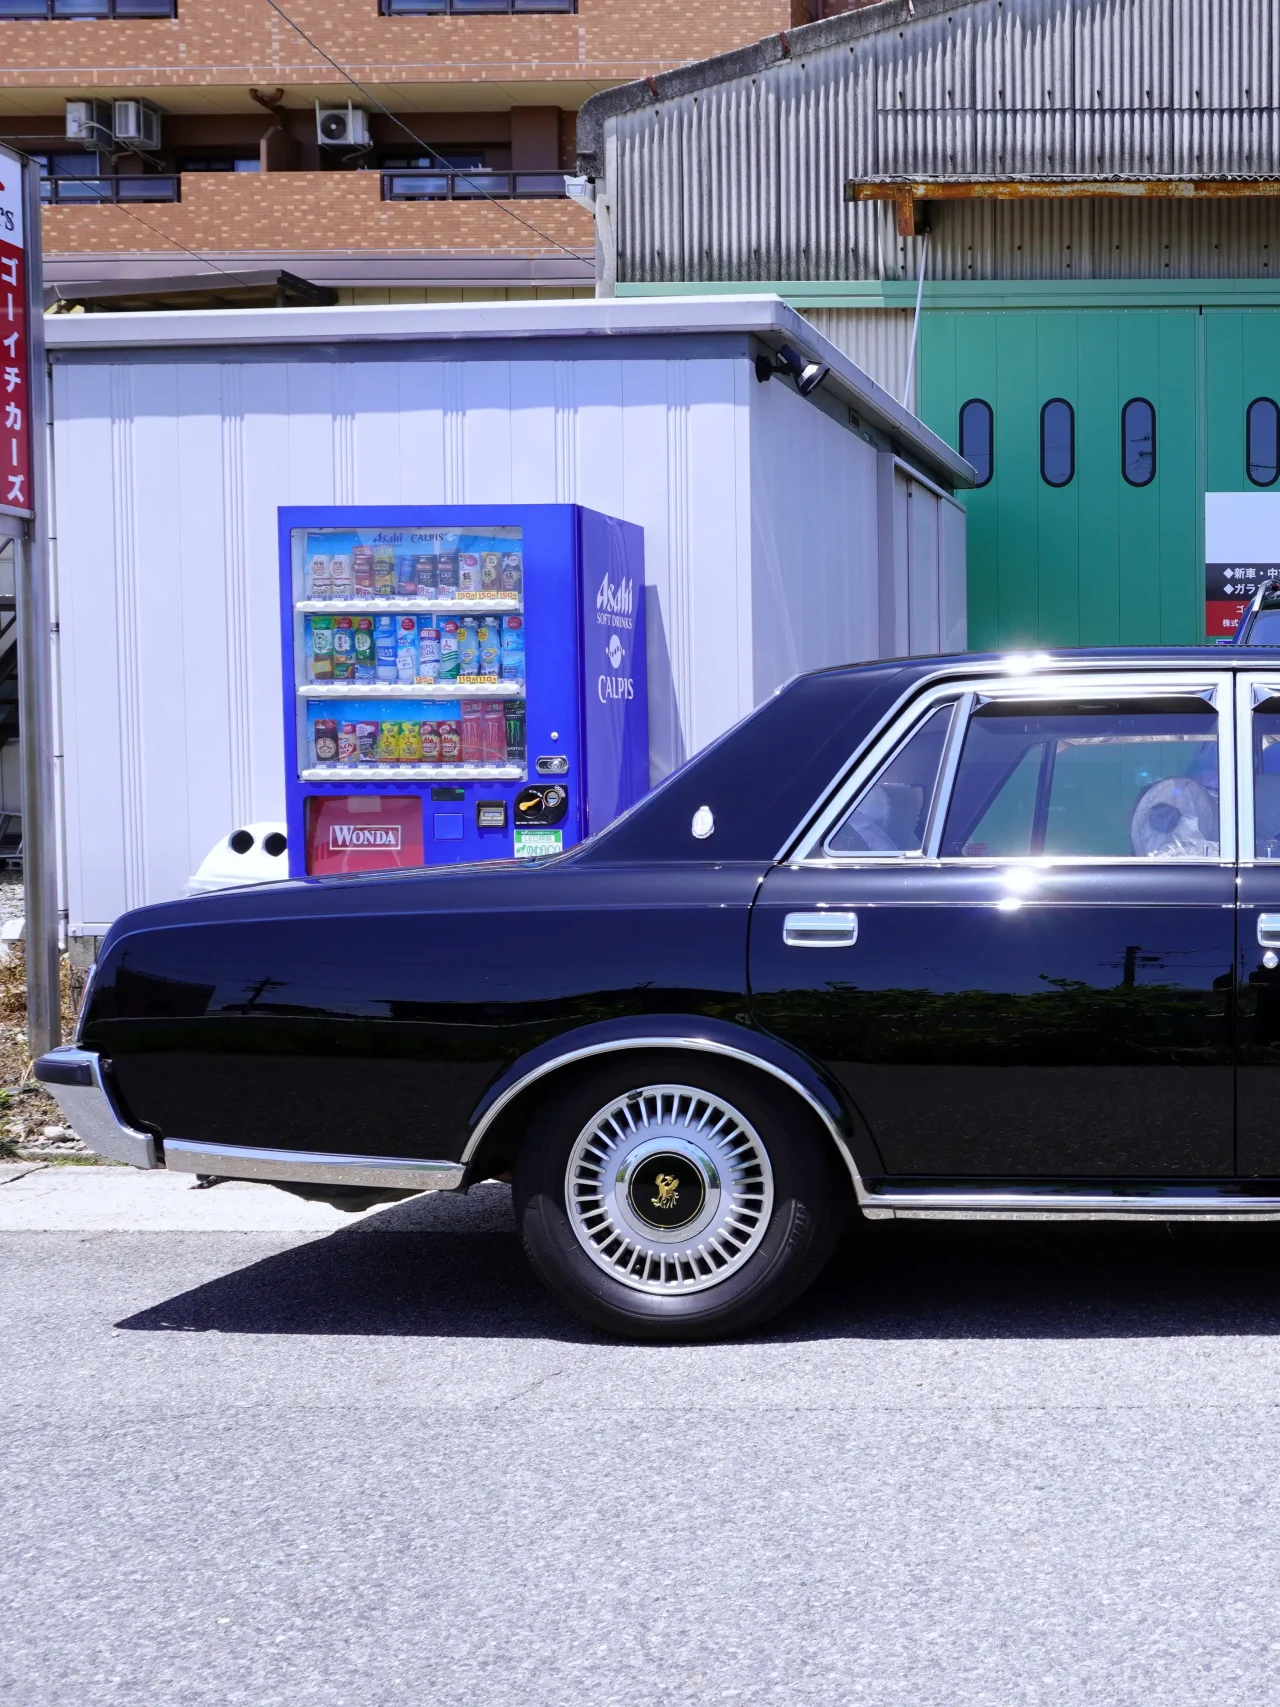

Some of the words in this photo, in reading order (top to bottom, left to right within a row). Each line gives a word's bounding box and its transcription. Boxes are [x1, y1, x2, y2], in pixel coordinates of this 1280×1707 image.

[1, 256, 25, 503] ゴーイチカーズ
[373, 532, 403, 544] Asahi
[410, 533, 443, 544] CALPIS
[597, 572, 632, 615] Asahi
[597, 613, 611, 626] SOFT
[612, 615, 632, 629] DRINKS
[598, 675, 634, 704] CALPIS
[333, 825, 396, 846] WONDA
